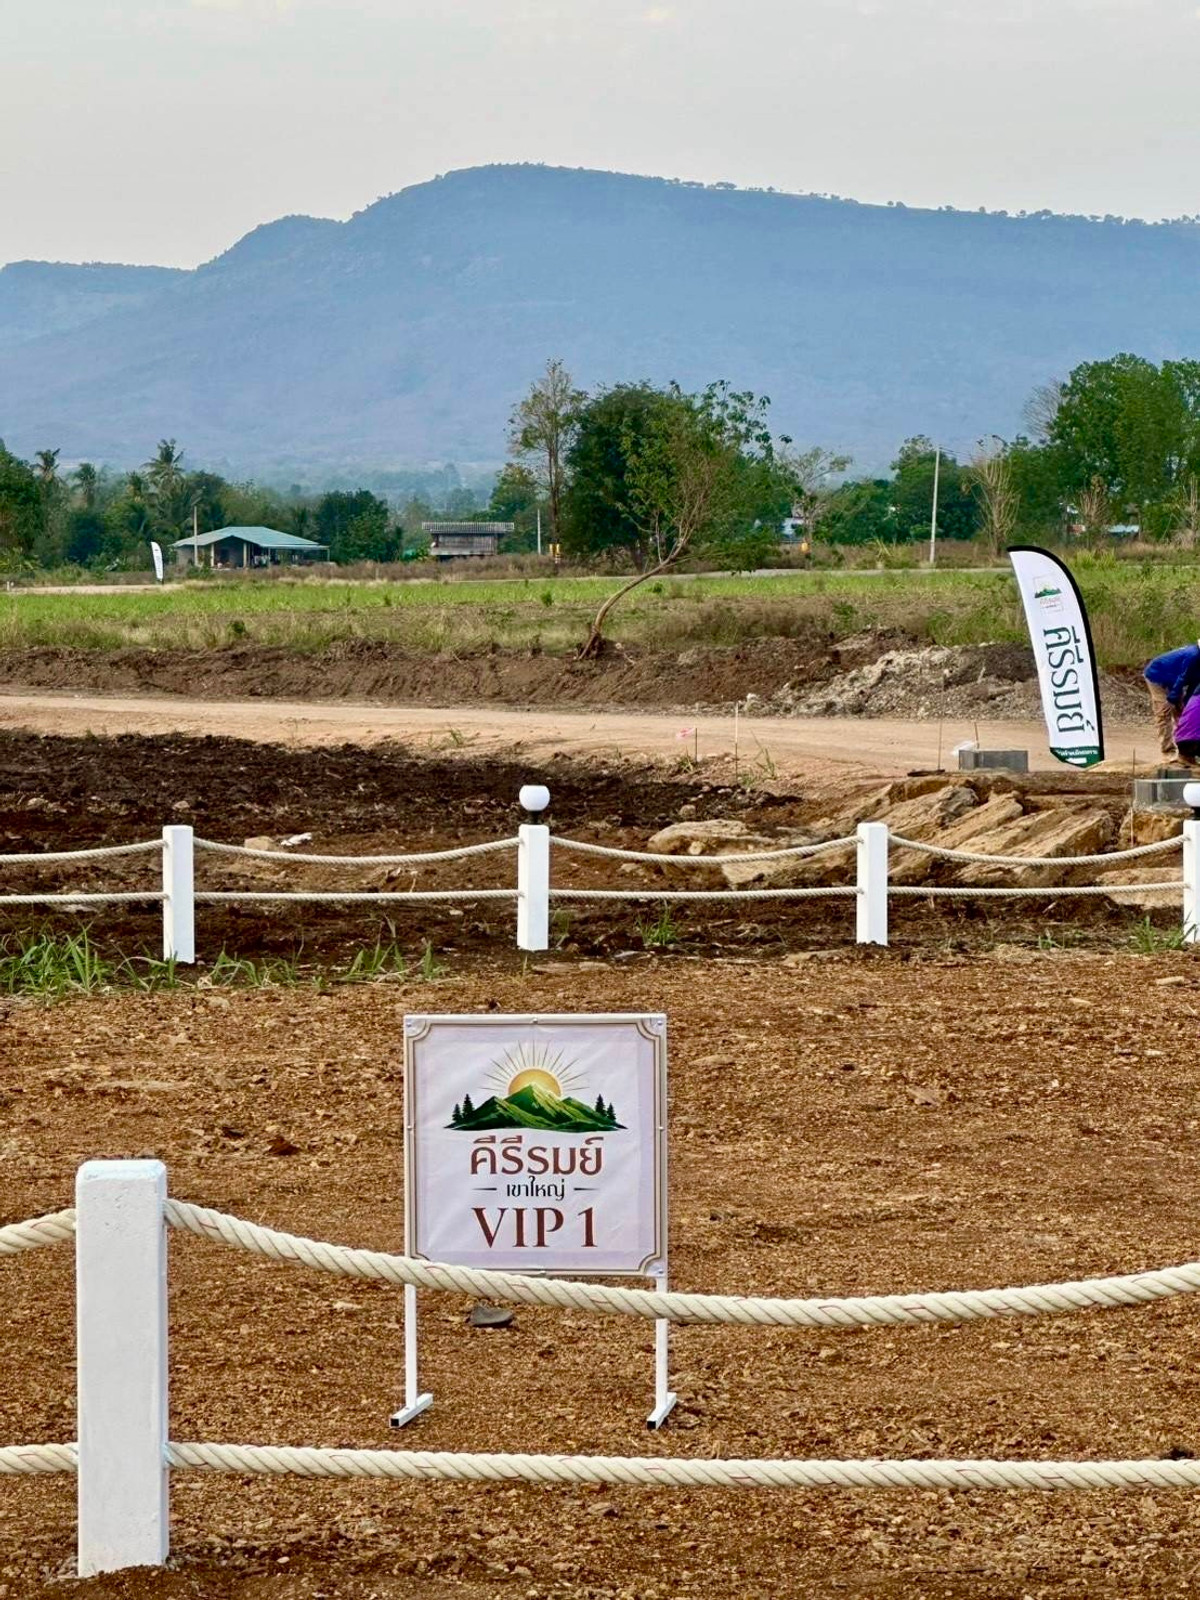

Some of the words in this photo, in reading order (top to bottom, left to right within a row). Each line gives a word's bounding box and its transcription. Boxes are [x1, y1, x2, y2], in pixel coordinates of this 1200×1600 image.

[1043, 625, 1095, 733] คีรีรมย์
[470, 1135, 604, 1175] คีรีรมย์
[506, 1175, 565, 1201] เขาใหญ่
[471, 1207, 564, 1248] VIP
[577, 1206, 598, 1248] 1
